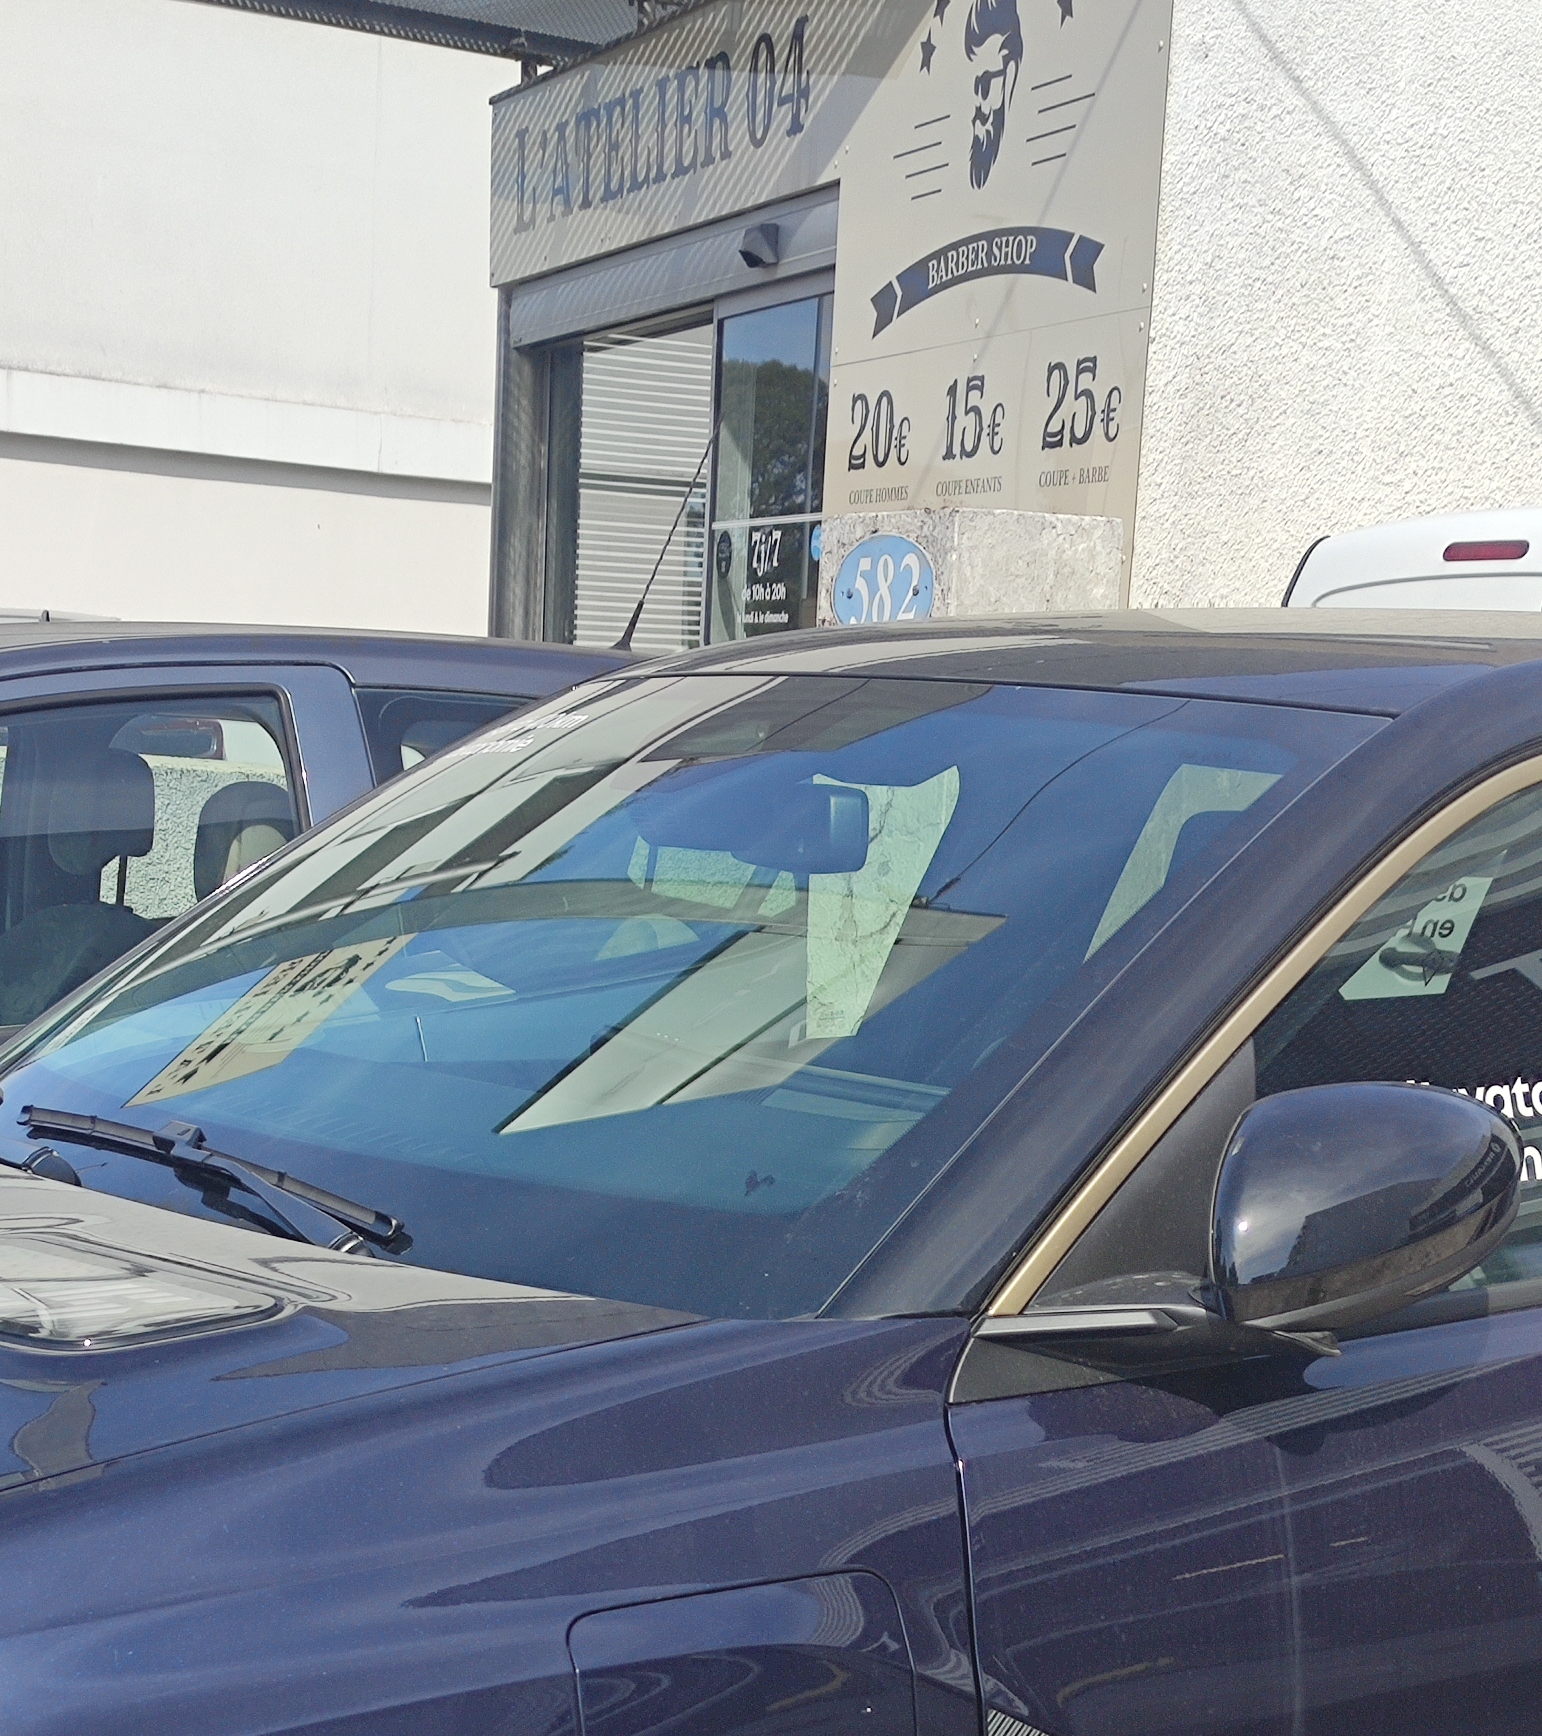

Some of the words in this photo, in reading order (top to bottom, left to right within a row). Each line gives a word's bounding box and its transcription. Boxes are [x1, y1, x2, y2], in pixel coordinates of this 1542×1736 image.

[512, 50, 733, 235] L'ATELIER
[745, 14, 811, 149] 04
[927, 239, 989, 290] BARBER
[991, 235, 1037, 267] SHOP
[847, 389, 911, 472] 20€
[941, 374, 1005, 461] 15€
[1041, 355, 1122, 451] 25€
[848, 487, 875, 505] COUPE
[875, 485, 909, 503] HOMMES
[935, 479, 963, 497] COUPE
[964, 476, 1002, 495] ENFANTS
[1038, 468, 1070, 488] COUPE
[1078, 465, 1110, 484] BARBE
[751, 529, 782, 577] 7j/7
[741, 583, 751, 601] de
[752, 583, 765, 601] 10h
[771, 582, 786, 600] 20h
[849, 553, 920, 624] 582
